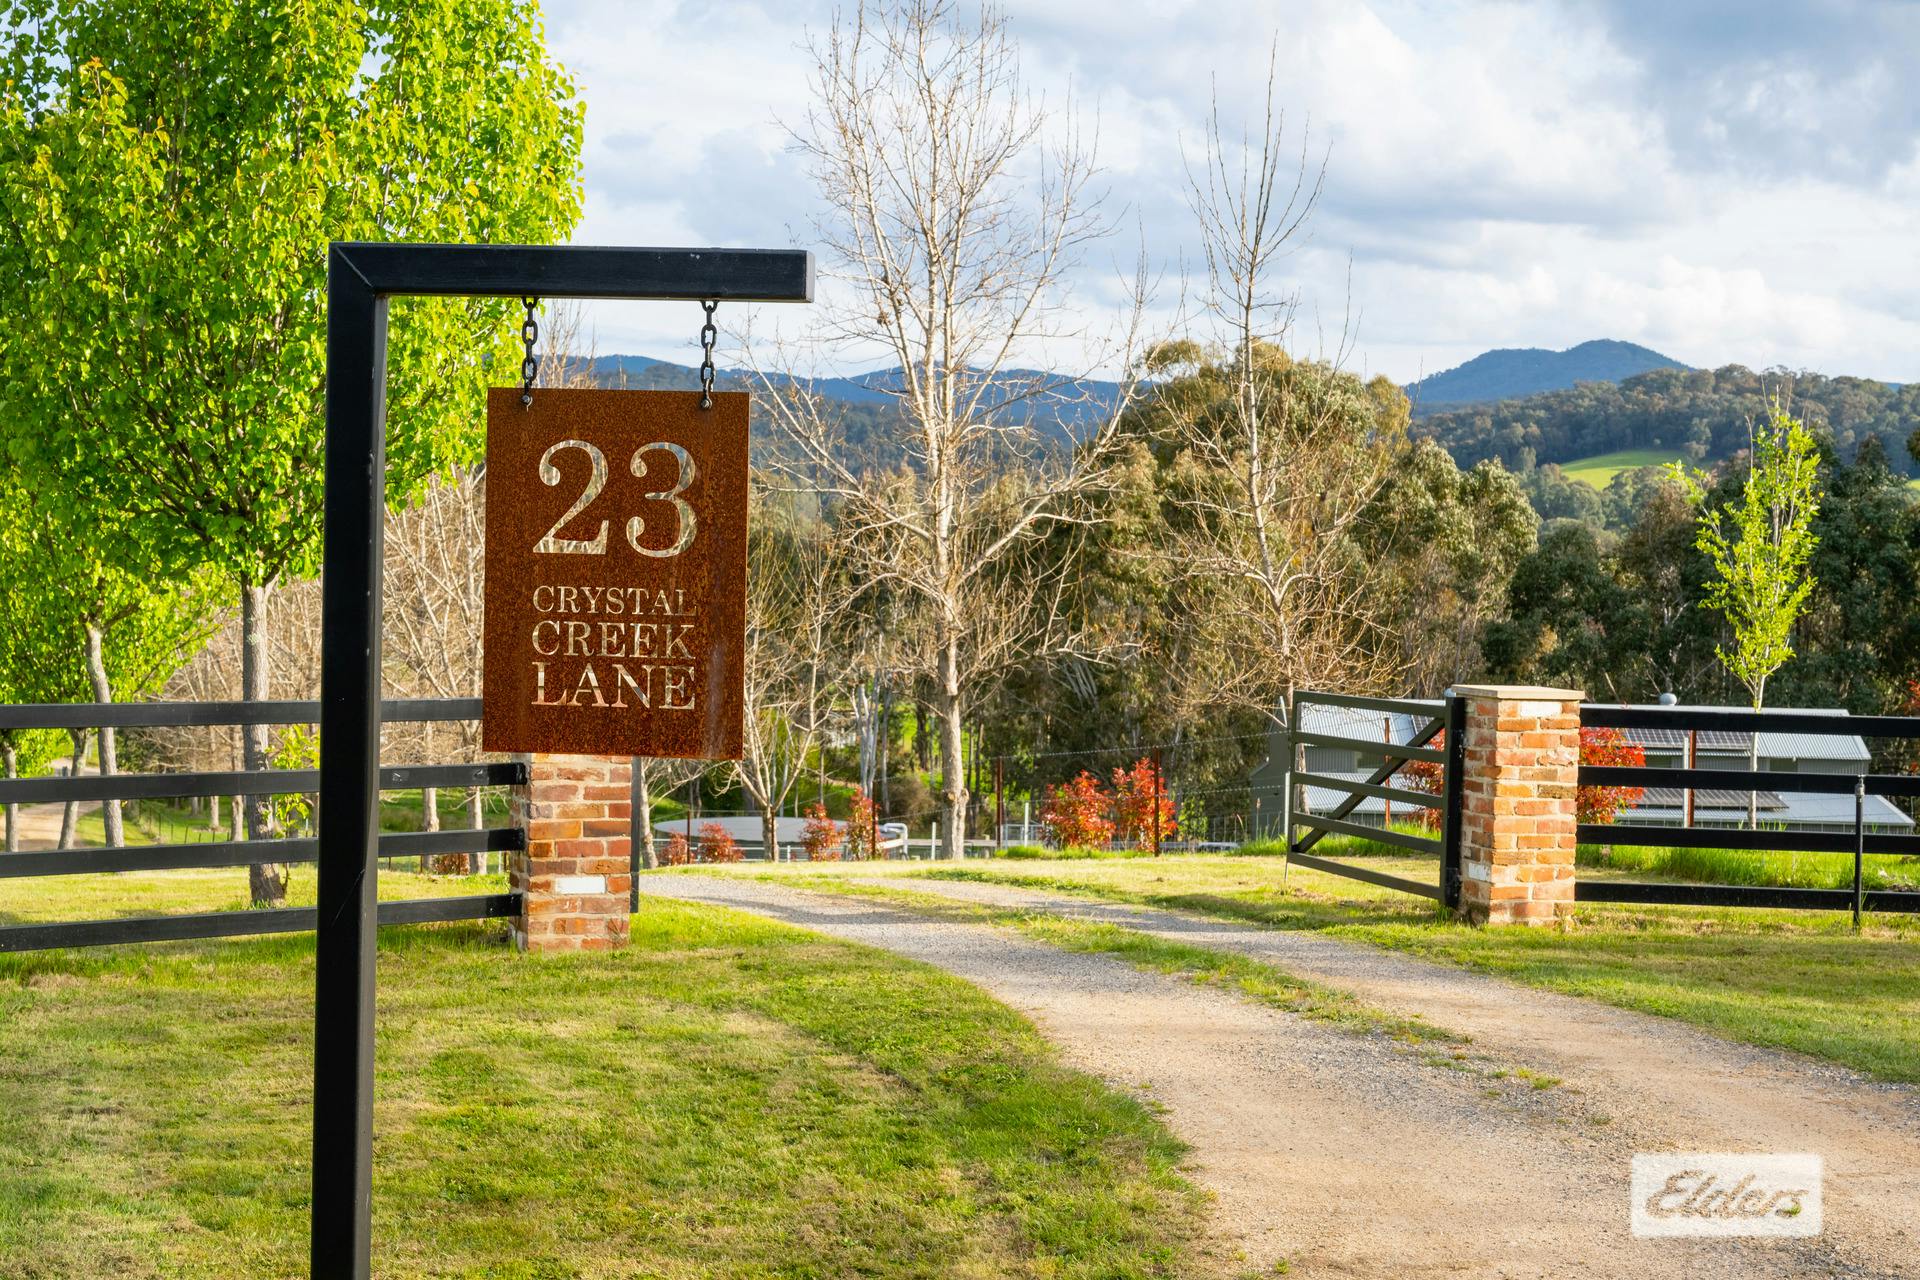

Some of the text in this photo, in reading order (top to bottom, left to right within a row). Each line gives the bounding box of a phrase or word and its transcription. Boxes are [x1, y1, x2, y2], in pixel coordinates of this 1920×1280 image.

[532, 439, 698, 557] 23
[532, 585, 697, 617] CRYSTAL
[531, 620, 697, 660] CREEK
[531, 661, 696, 710] LANE
